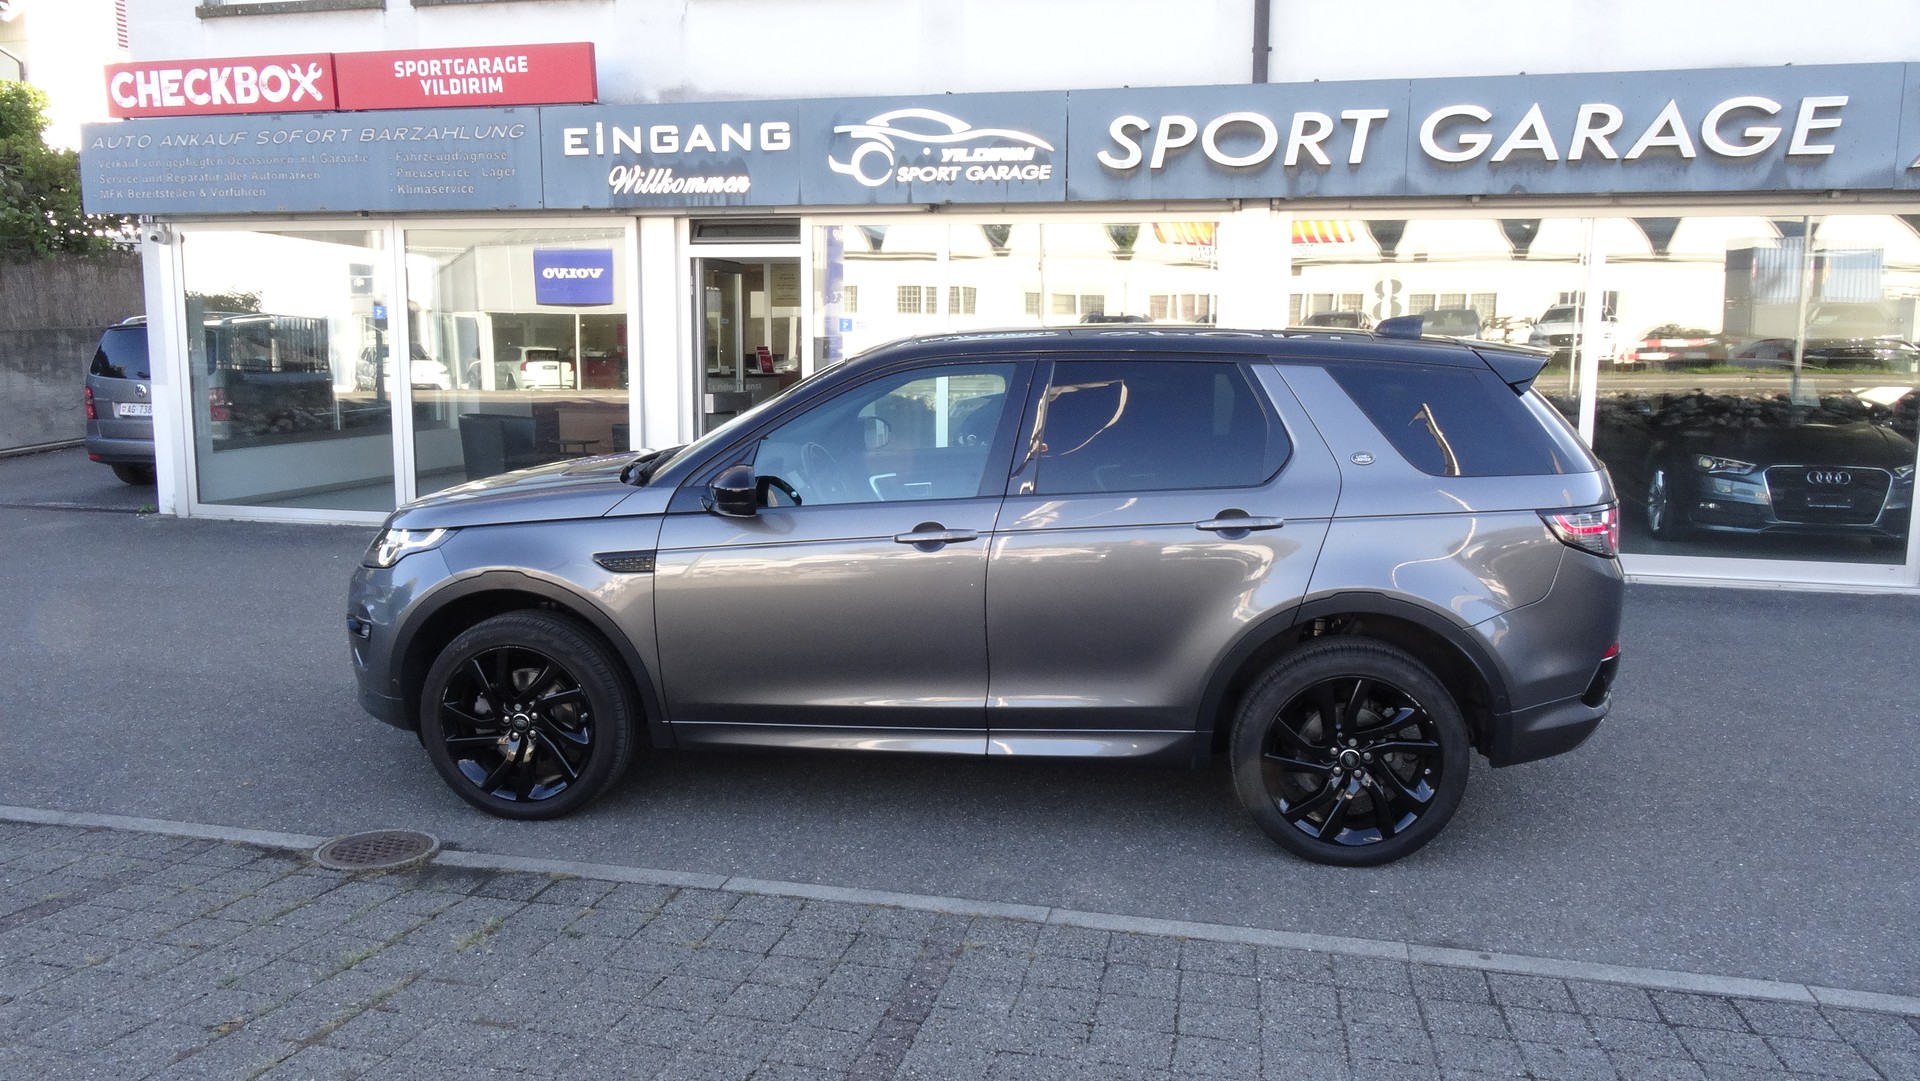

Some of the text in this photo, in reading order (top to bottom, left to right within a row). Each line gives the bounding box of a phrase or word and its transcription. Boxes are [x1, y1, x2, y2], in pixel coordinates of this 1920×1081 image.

[394, 55, 529, 78] SPORTGARAGE
[110, 62, 323, 109] CHECKBOX
[420, 76, 504, 96] YILDIRIM
[91, 123, 526, 150] AUTO ANKAUF SOFORT BARZAHLUNG
[563, 121, 791, 156] EINGANG
[1096, 95, 1849, 170] SPORT GARAGE
[98, 157, 139, 169] Verkauf
[320, 152, 369, 163] Garantie
[395, 151, 508, 164] Fahrzeugdiagnose
[100, 171, 321, 185] Service und Reparatur aller Automarken
[481, 167, 517, 180] Lager
[608, 165, 751, 195] Willkommen
[896, 164, 1052, 183] SPORT GARAGE
[100, 190, 124, 200] MFK
[128, 188, 196, 199] Bereitstellen
[199, 188, 207, 198] &
[397, 183, 475, 195] Klimaservice
